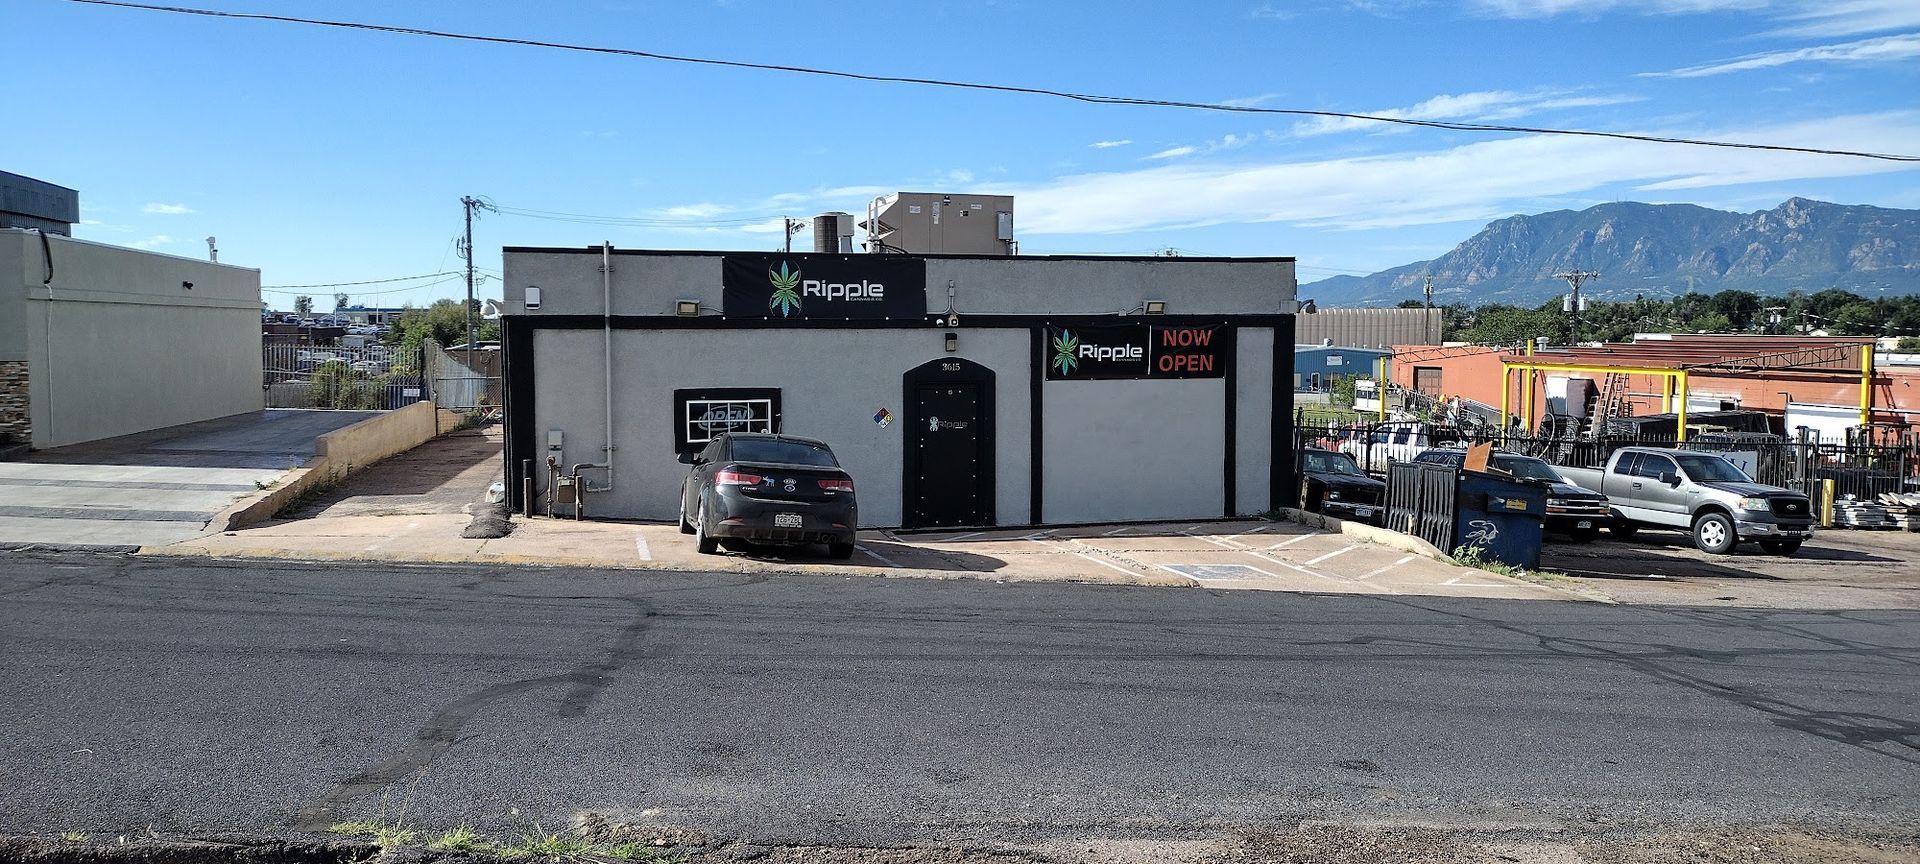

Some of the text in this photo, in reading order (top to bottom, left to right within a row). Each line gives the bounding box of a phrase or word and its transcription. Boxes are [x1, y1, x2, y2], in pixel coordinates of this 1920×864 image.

[803, 280, 884, 301] Ripple
[1163, 329, 1213, 346] NOW
[1079, 344, 1143, 361] Ripple
[942, 363, 961, 371] 3615
[1158, 354, 1214, 371] OPEN
[701, 410, 748, 426] OPEN
[938, 420, 968, 429] Ripple
